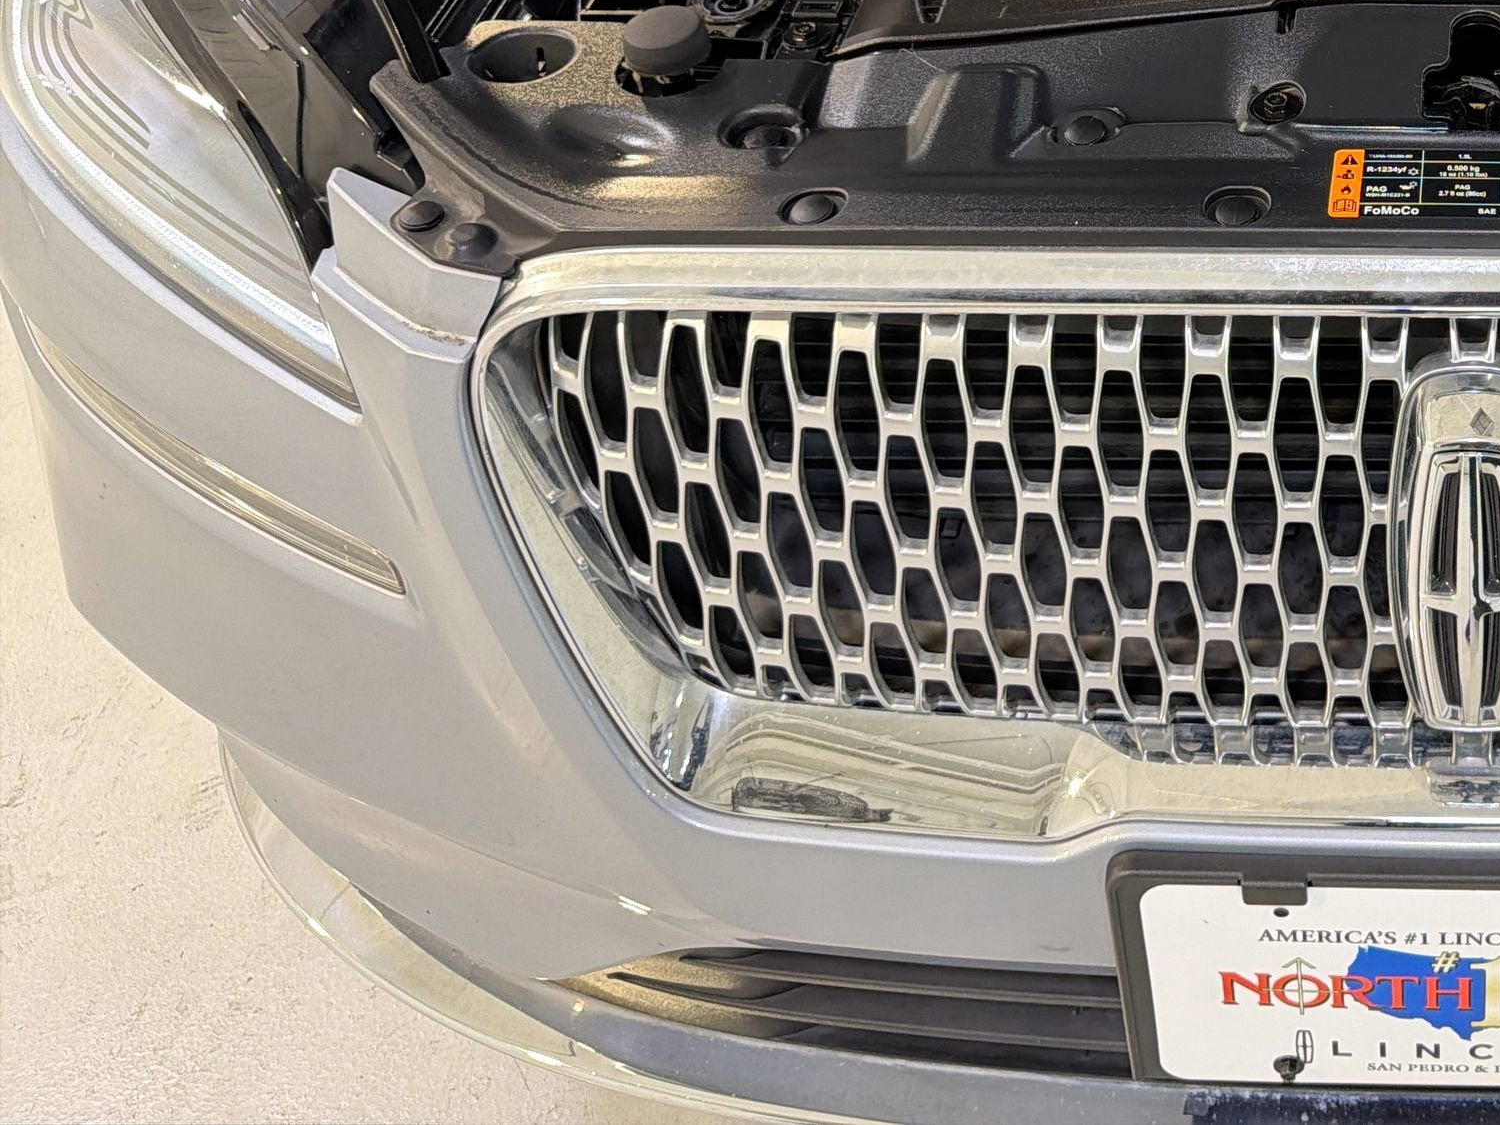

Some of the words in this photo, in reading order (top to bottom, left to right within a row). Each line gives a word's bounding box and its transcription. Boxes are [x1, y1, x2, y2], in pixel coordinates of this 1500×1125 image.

[1366, 166, 1407, 174] R-1234yf
[1364, 206, 1420, 215] FoMoCo
[1258, 929, 1397, 945] AMERICA'S
[1404, 931, 1430, 946] #1
[1218, 971, 1473, 1010] NORTH
[1367, 1062, 1402, 1072] SAN
[1408, 1063, 1470, 1073] PEDRO
[1474, 1064, 1489, 1074] &
